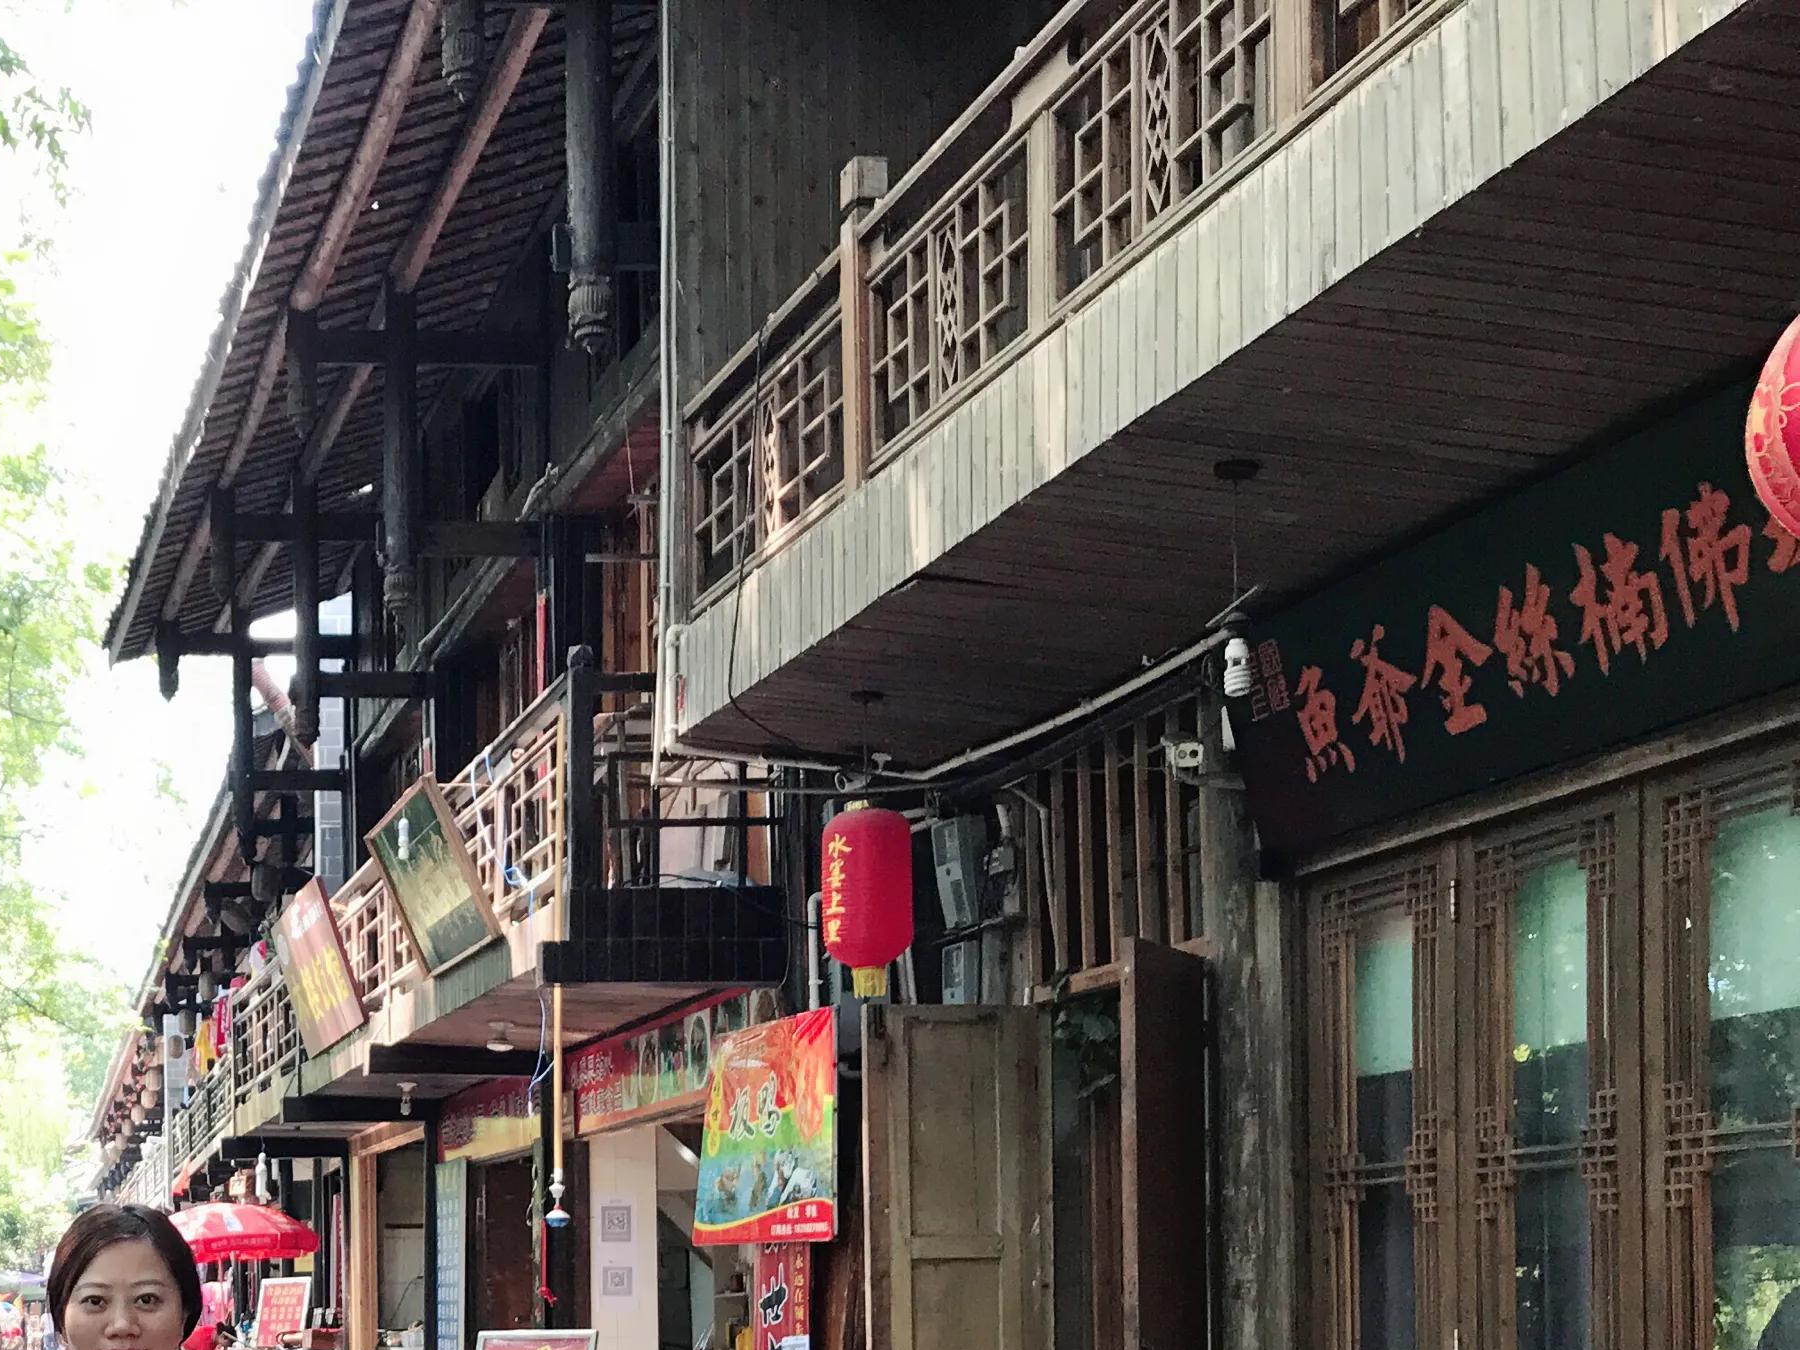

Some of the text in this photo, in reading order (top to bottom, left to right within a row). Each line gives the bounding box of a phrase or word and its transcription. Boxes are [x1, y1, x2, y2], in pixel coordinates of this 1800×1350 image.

[1295, 481, 1800, 783] 魚爺金絲楠佛
